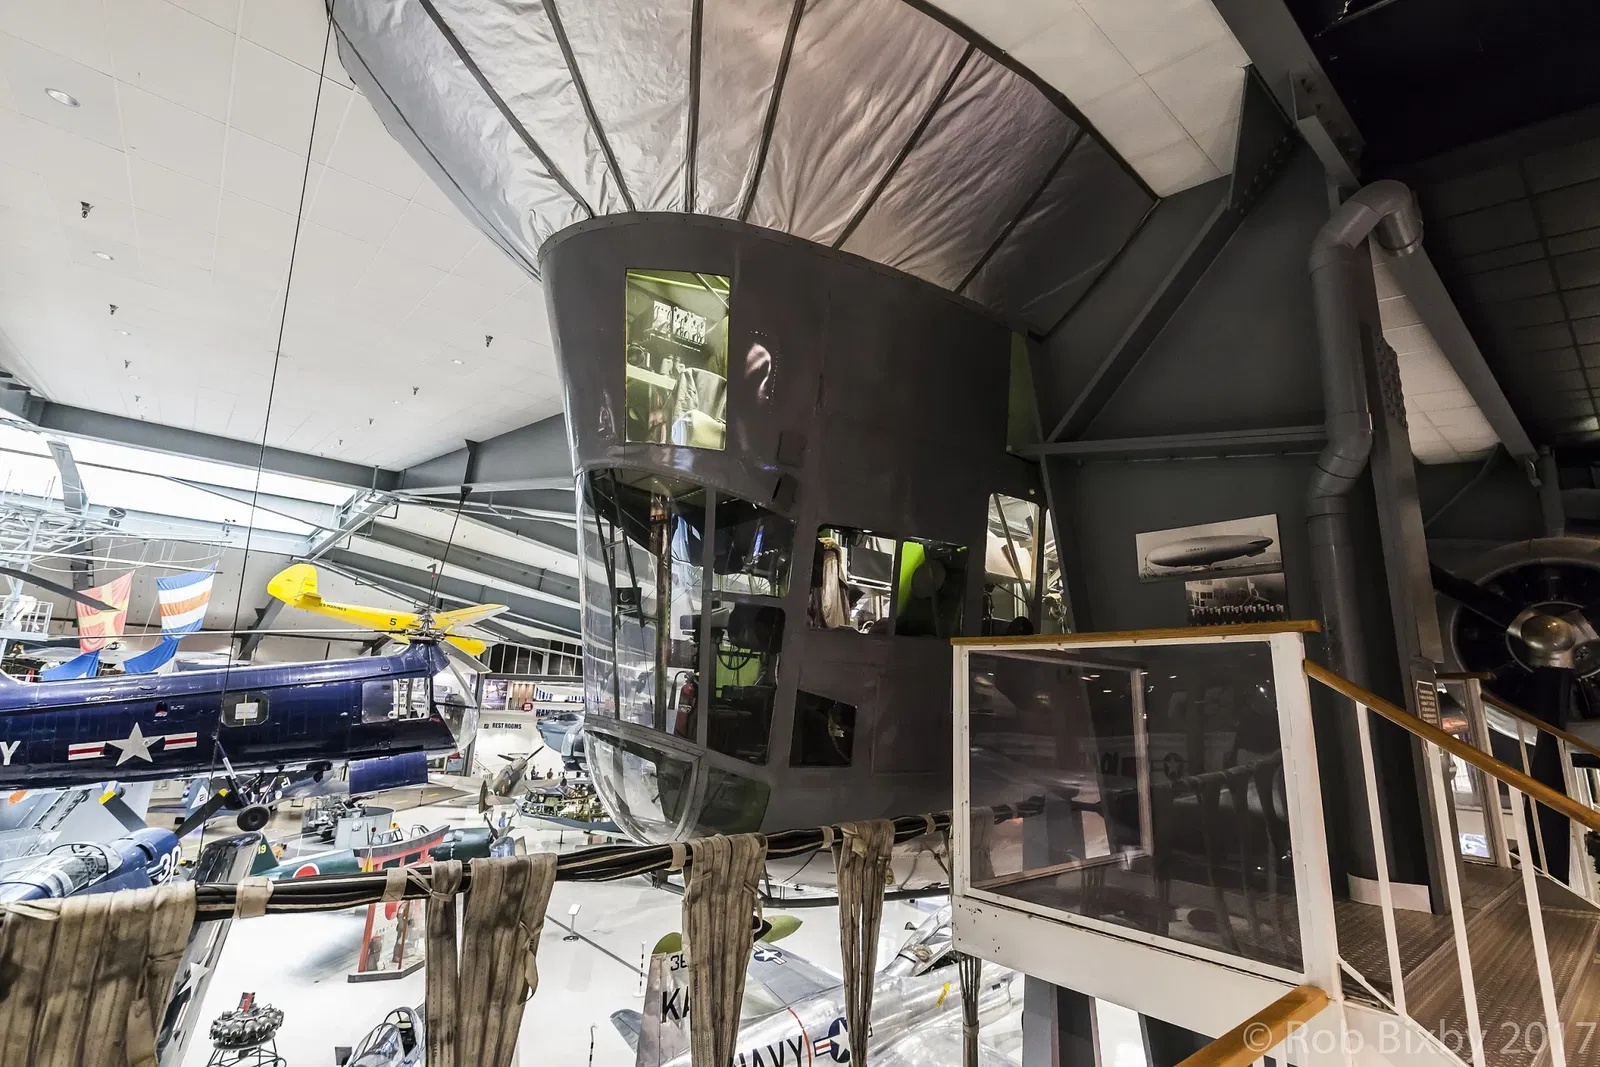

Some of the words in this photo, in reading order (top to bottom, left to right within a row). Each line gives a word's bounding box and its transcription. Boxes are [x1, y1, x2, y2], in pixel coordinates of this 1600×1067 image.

[389, 617, 397, 626] 5
[0, 740, 21, 766] Y
[281, 776, 291, 788] 21
[258, 844, 267, 854] 19
